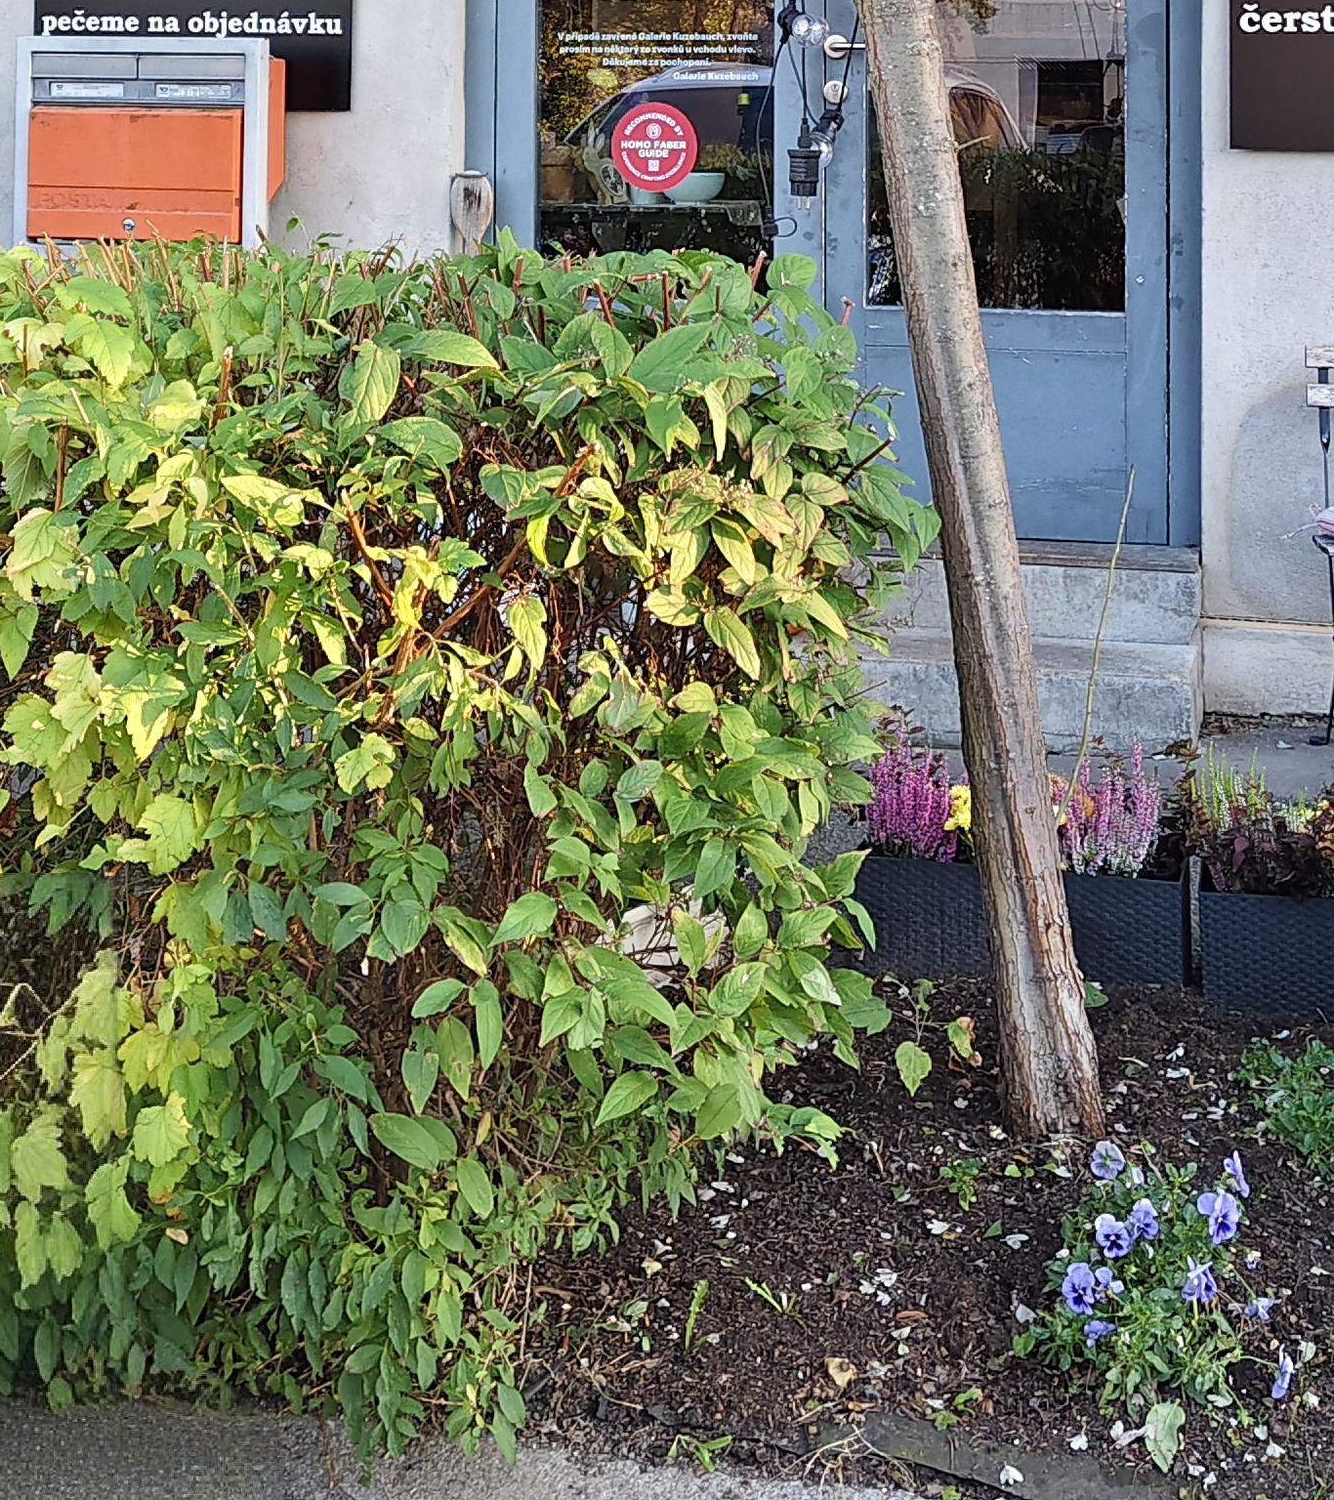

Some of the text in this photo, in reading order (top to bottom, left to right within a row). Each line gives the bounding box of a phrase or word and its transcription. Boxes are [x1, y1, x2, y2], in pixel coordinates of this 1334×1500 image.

[41, 10, 342, 38] pečeme na objednávku
[624, 112, 684, 136] RECOMMENDED BY
[620, 140, 687, 150] HOMO FABER
[638, 149, 670, 158] GUIDE
